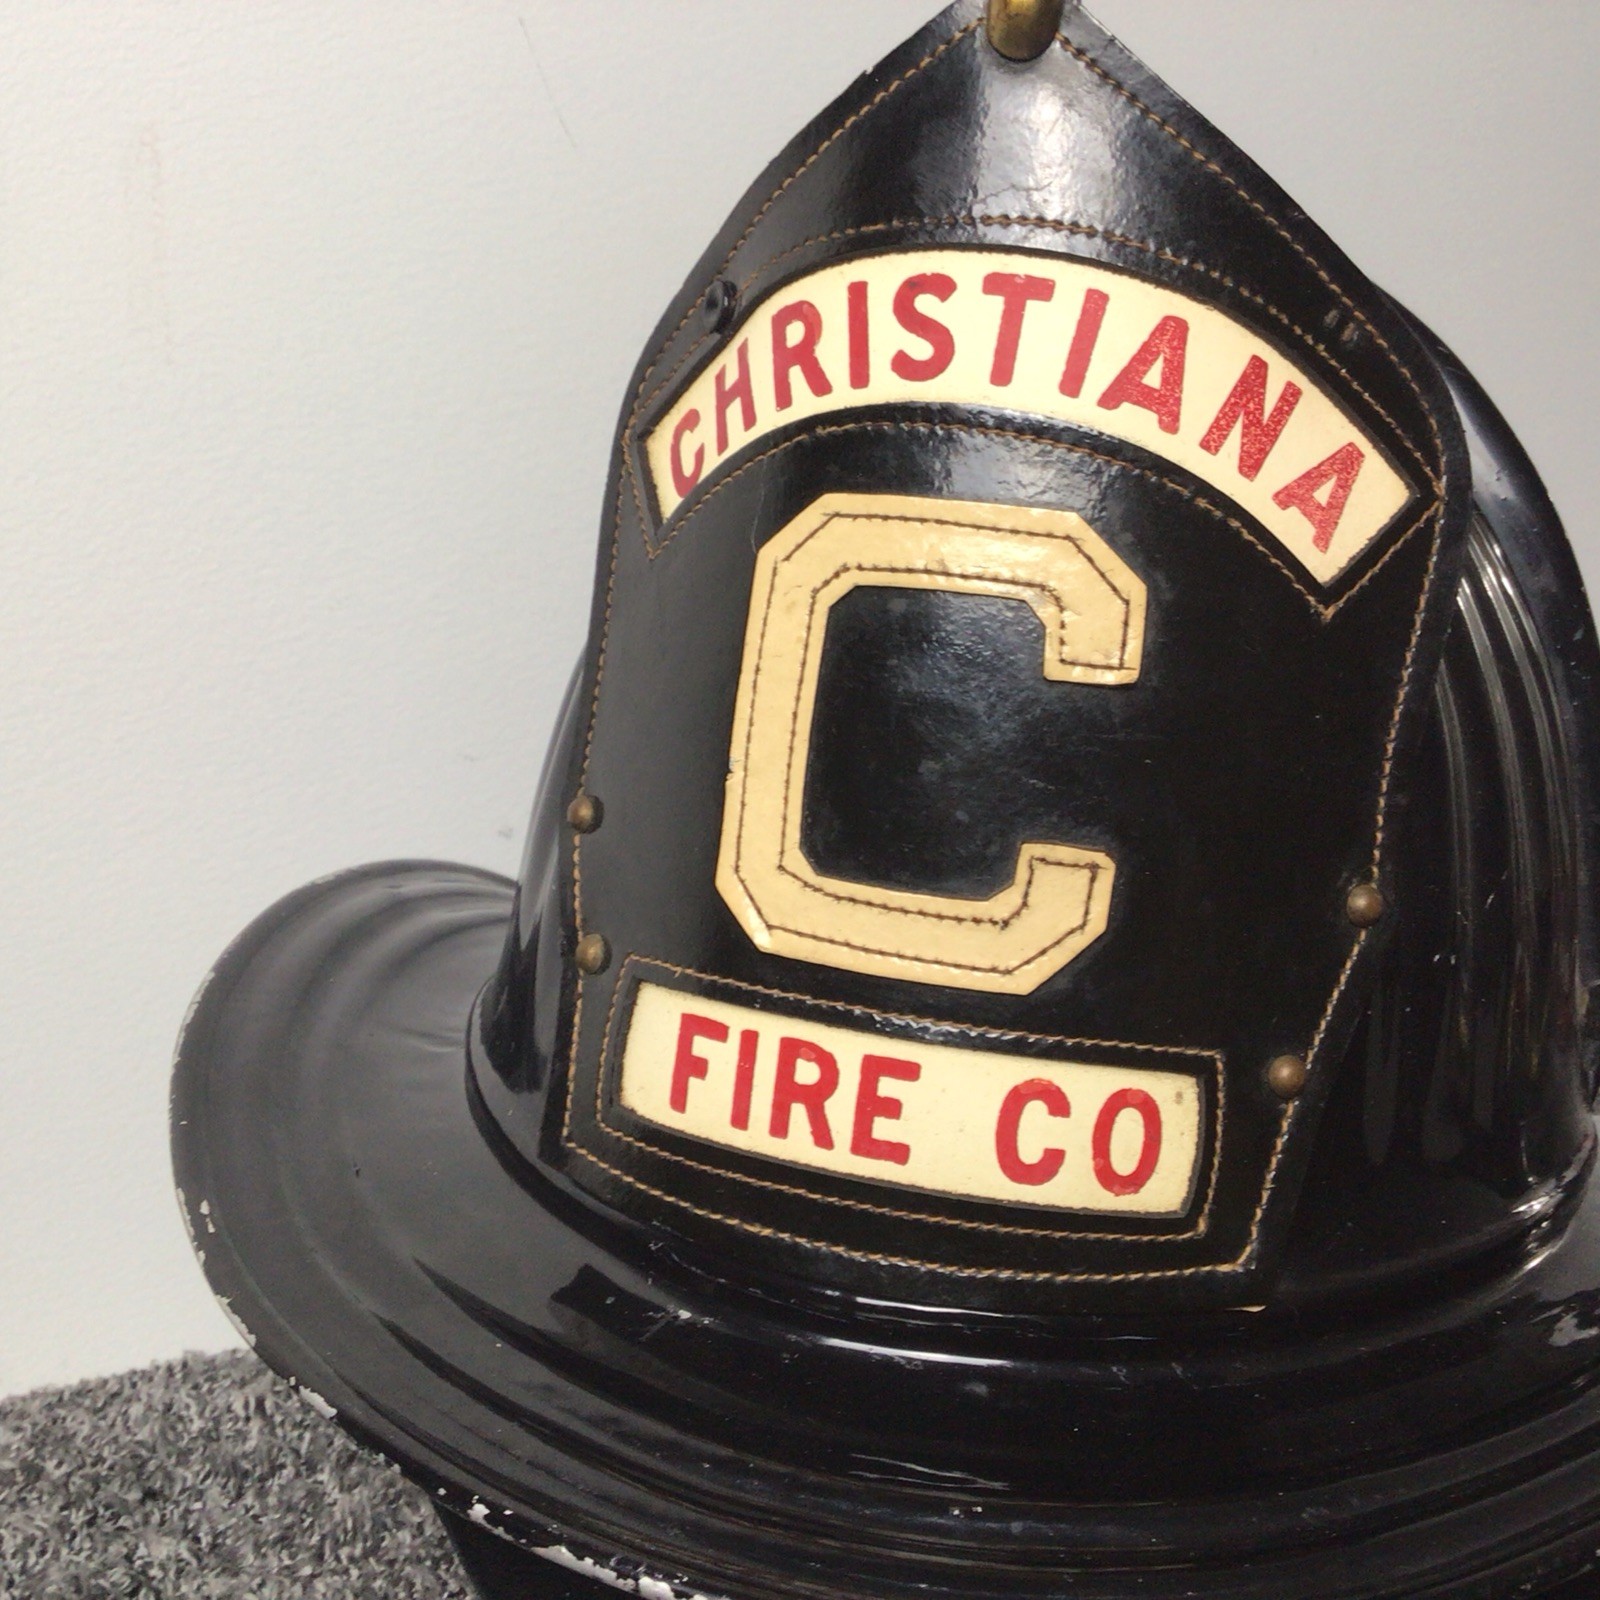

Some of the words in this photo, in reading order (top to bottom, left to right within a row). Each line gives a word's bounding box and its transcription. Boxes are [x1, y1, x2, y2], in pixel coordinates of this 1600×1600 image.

[670, 271, 1364, 553] CHRISTIANA
[715, 492, 1149, 996] C
[669, 1012, 921, 1166] FIRE
[995, 1078, 1163, 1197] CO
